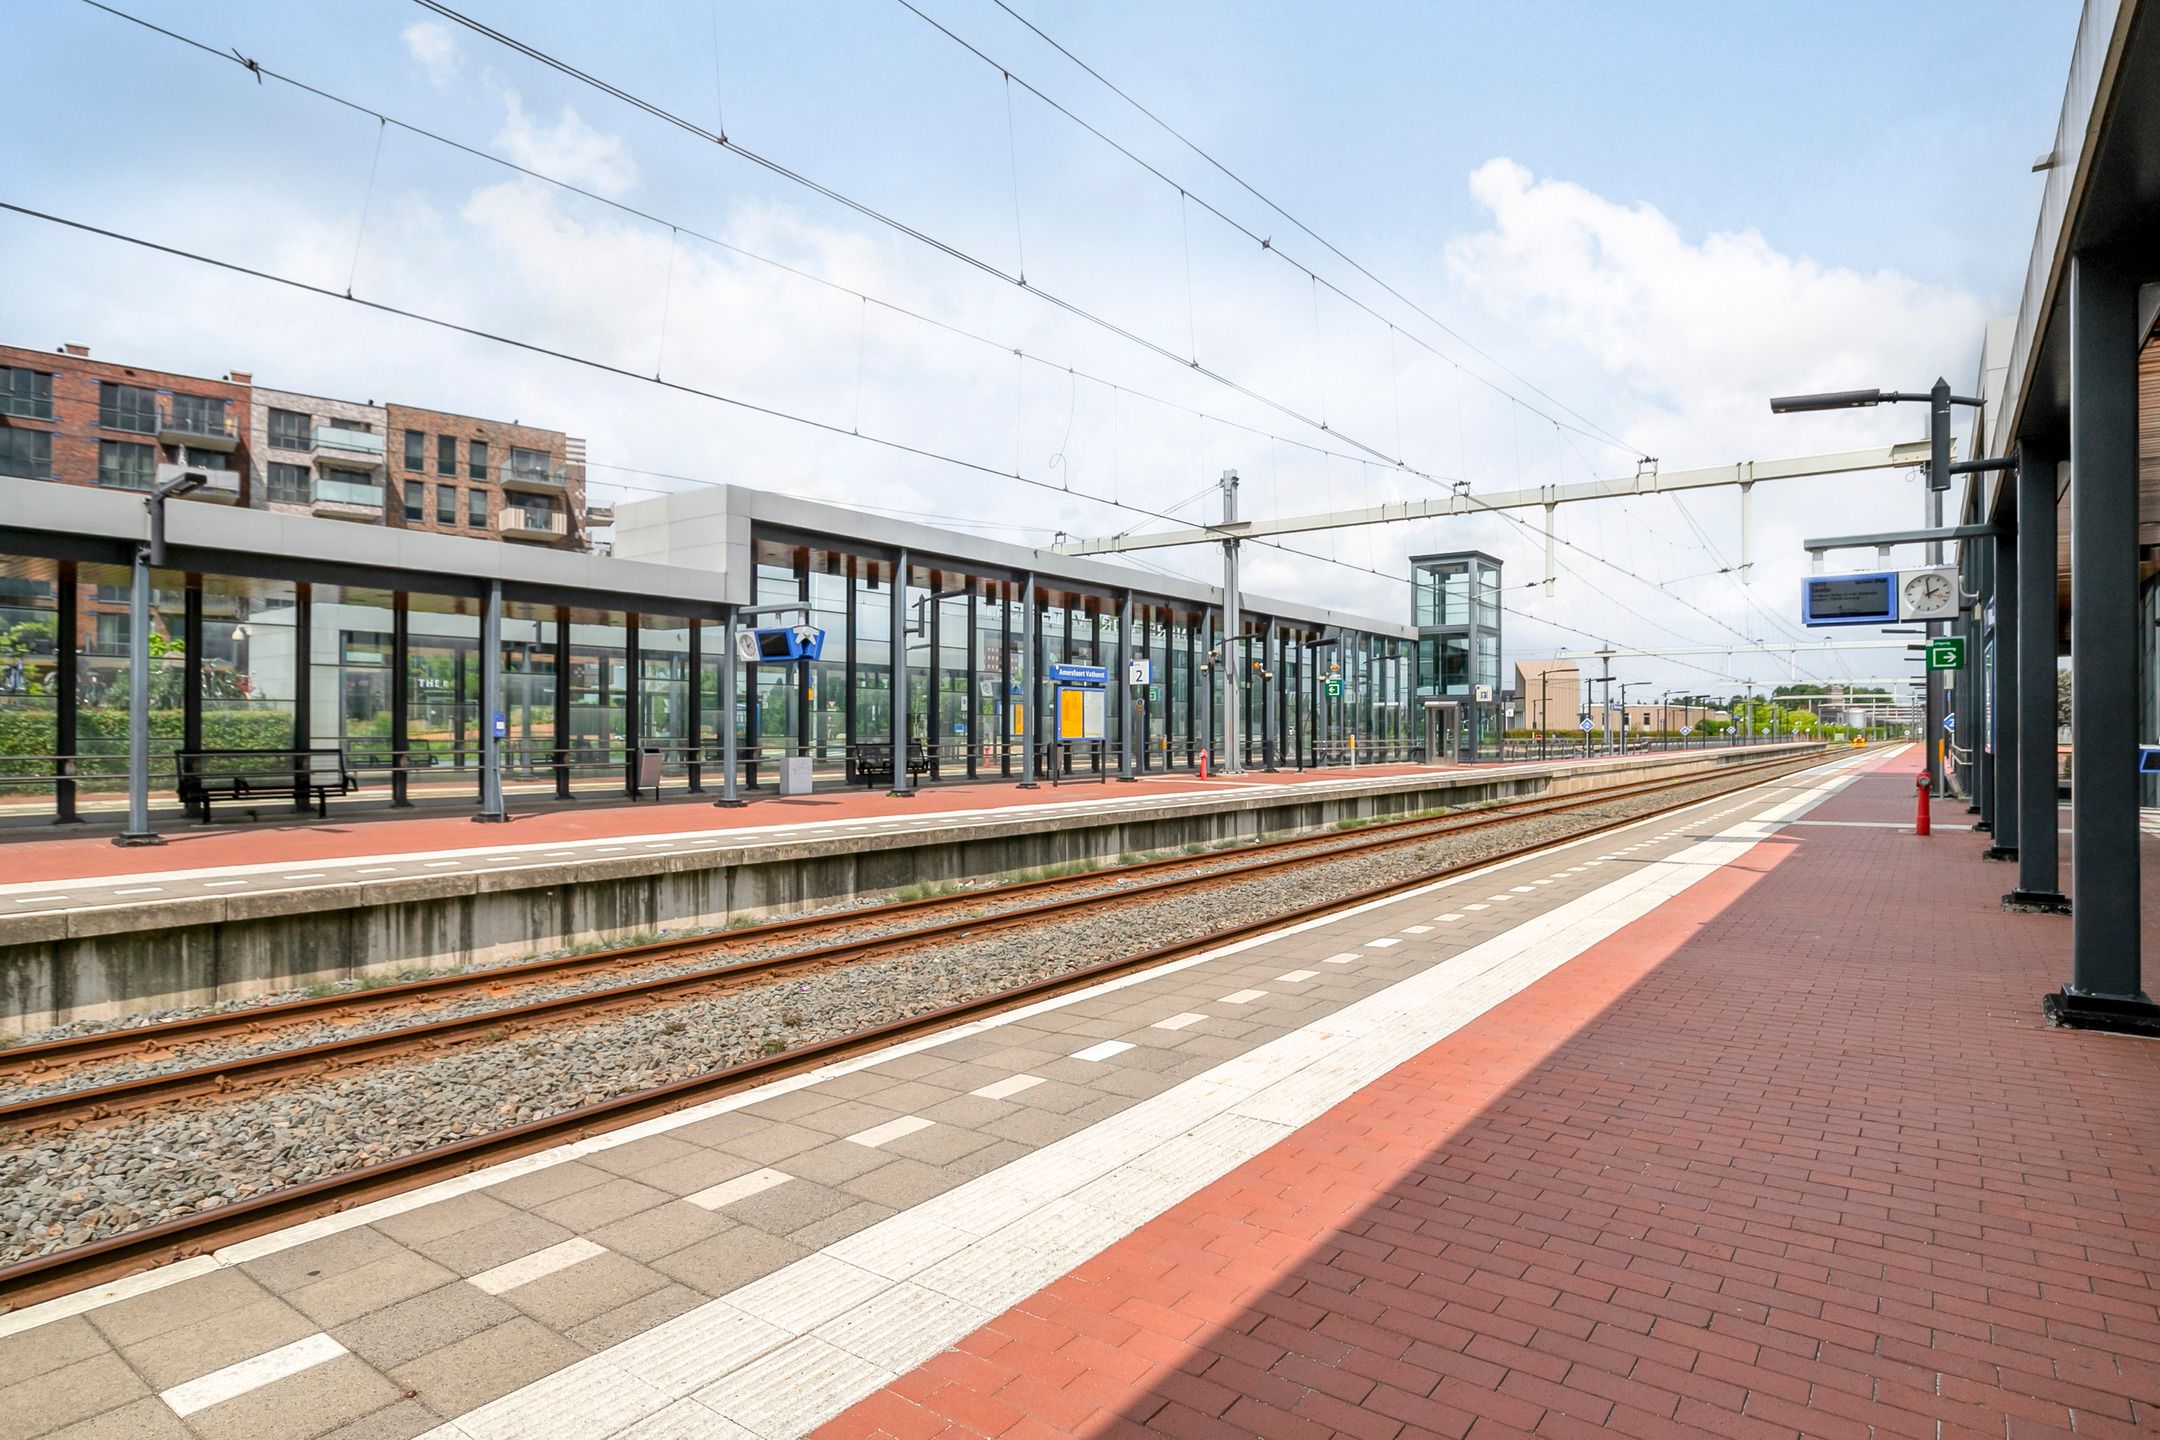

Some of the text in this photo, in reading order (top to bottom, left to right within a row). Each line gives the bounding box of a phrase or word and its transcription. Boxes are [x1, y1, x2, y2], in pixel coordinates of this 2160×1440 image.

[1059, 669, 1105, 679] Amersfoort Vathorst
[1135, 669, 1143, 682] 2
